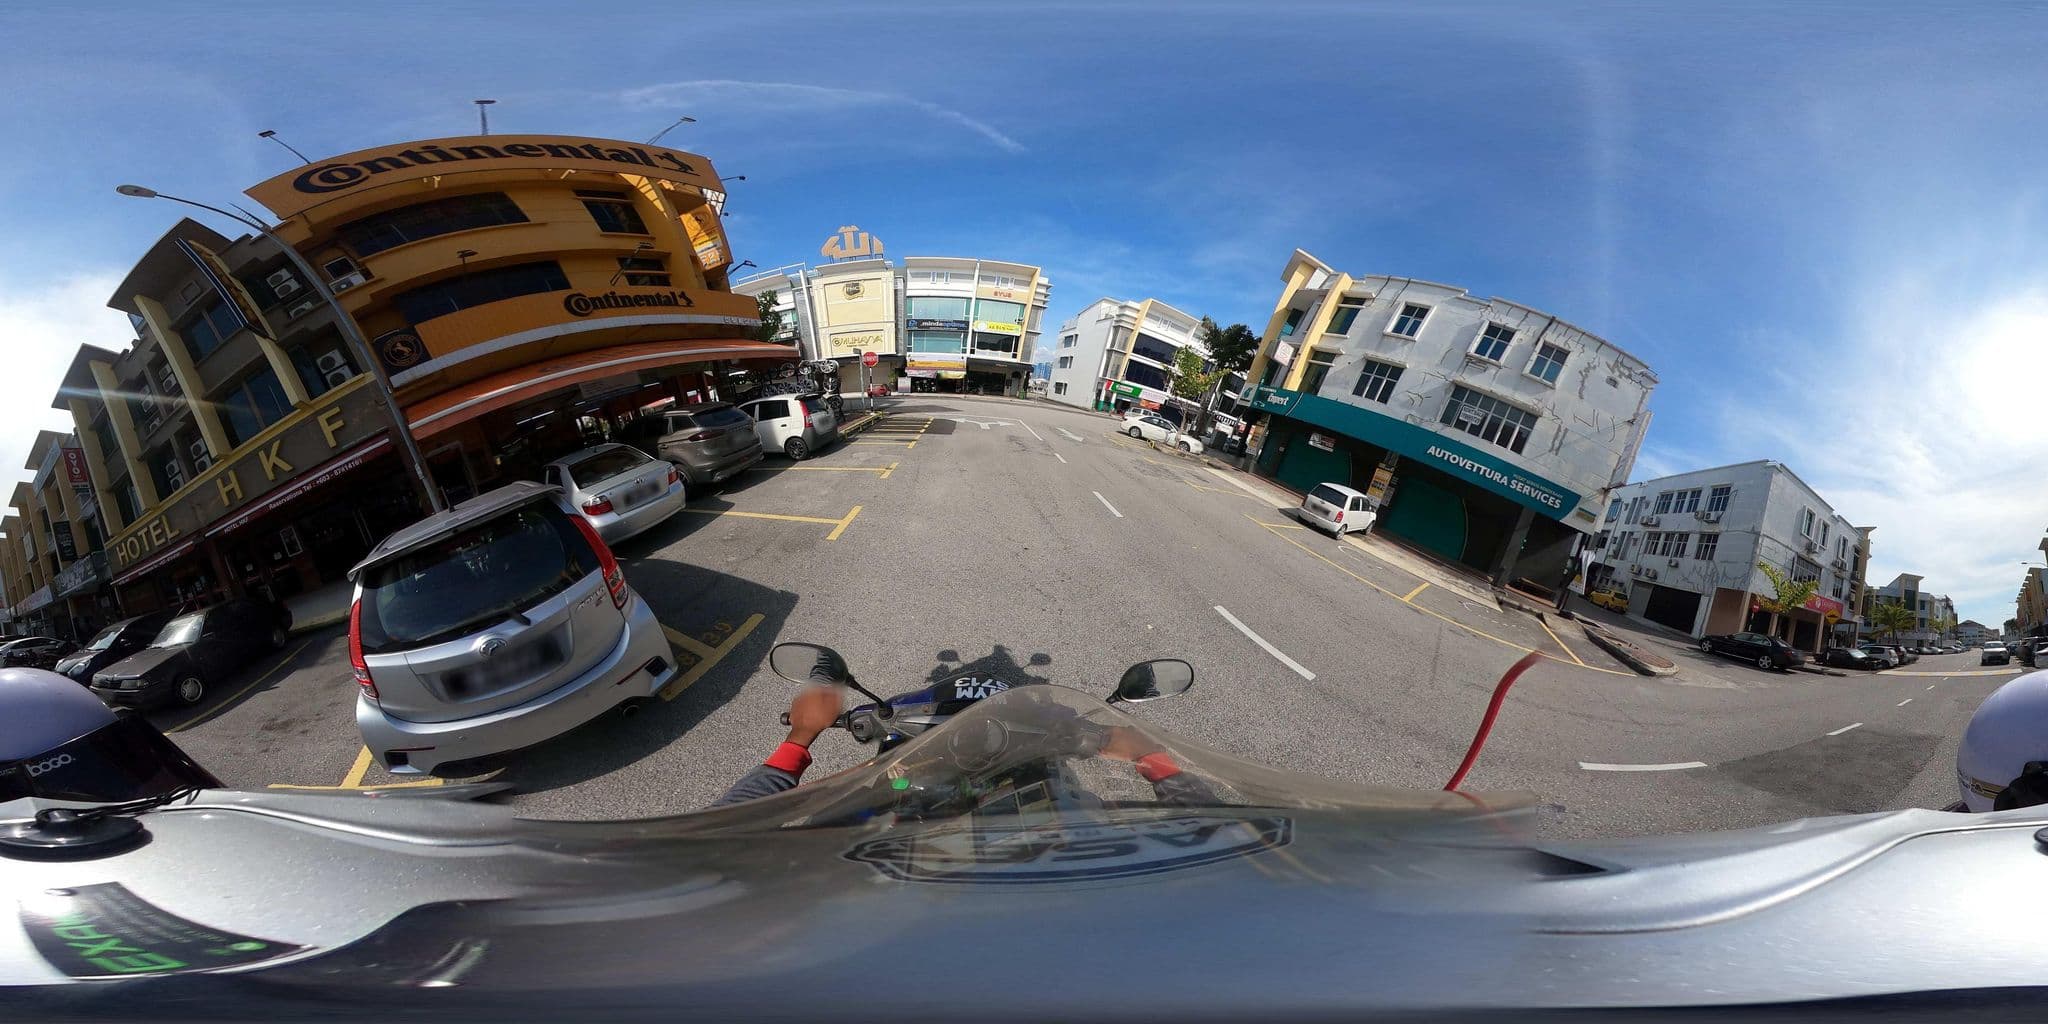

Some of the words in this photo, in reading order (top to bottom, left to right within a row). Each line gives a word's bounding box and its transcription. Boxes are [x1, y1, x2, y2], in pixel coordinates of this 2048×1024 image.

[293, 143, 659, 194] Continental
[563, 291, 680, 317] Continental
[1427, 445, 1509, 488] AUTOVETTURA
[1509, 479, 1562, 509] SERVICES
[116, 513, 181, 566] HOTEL
